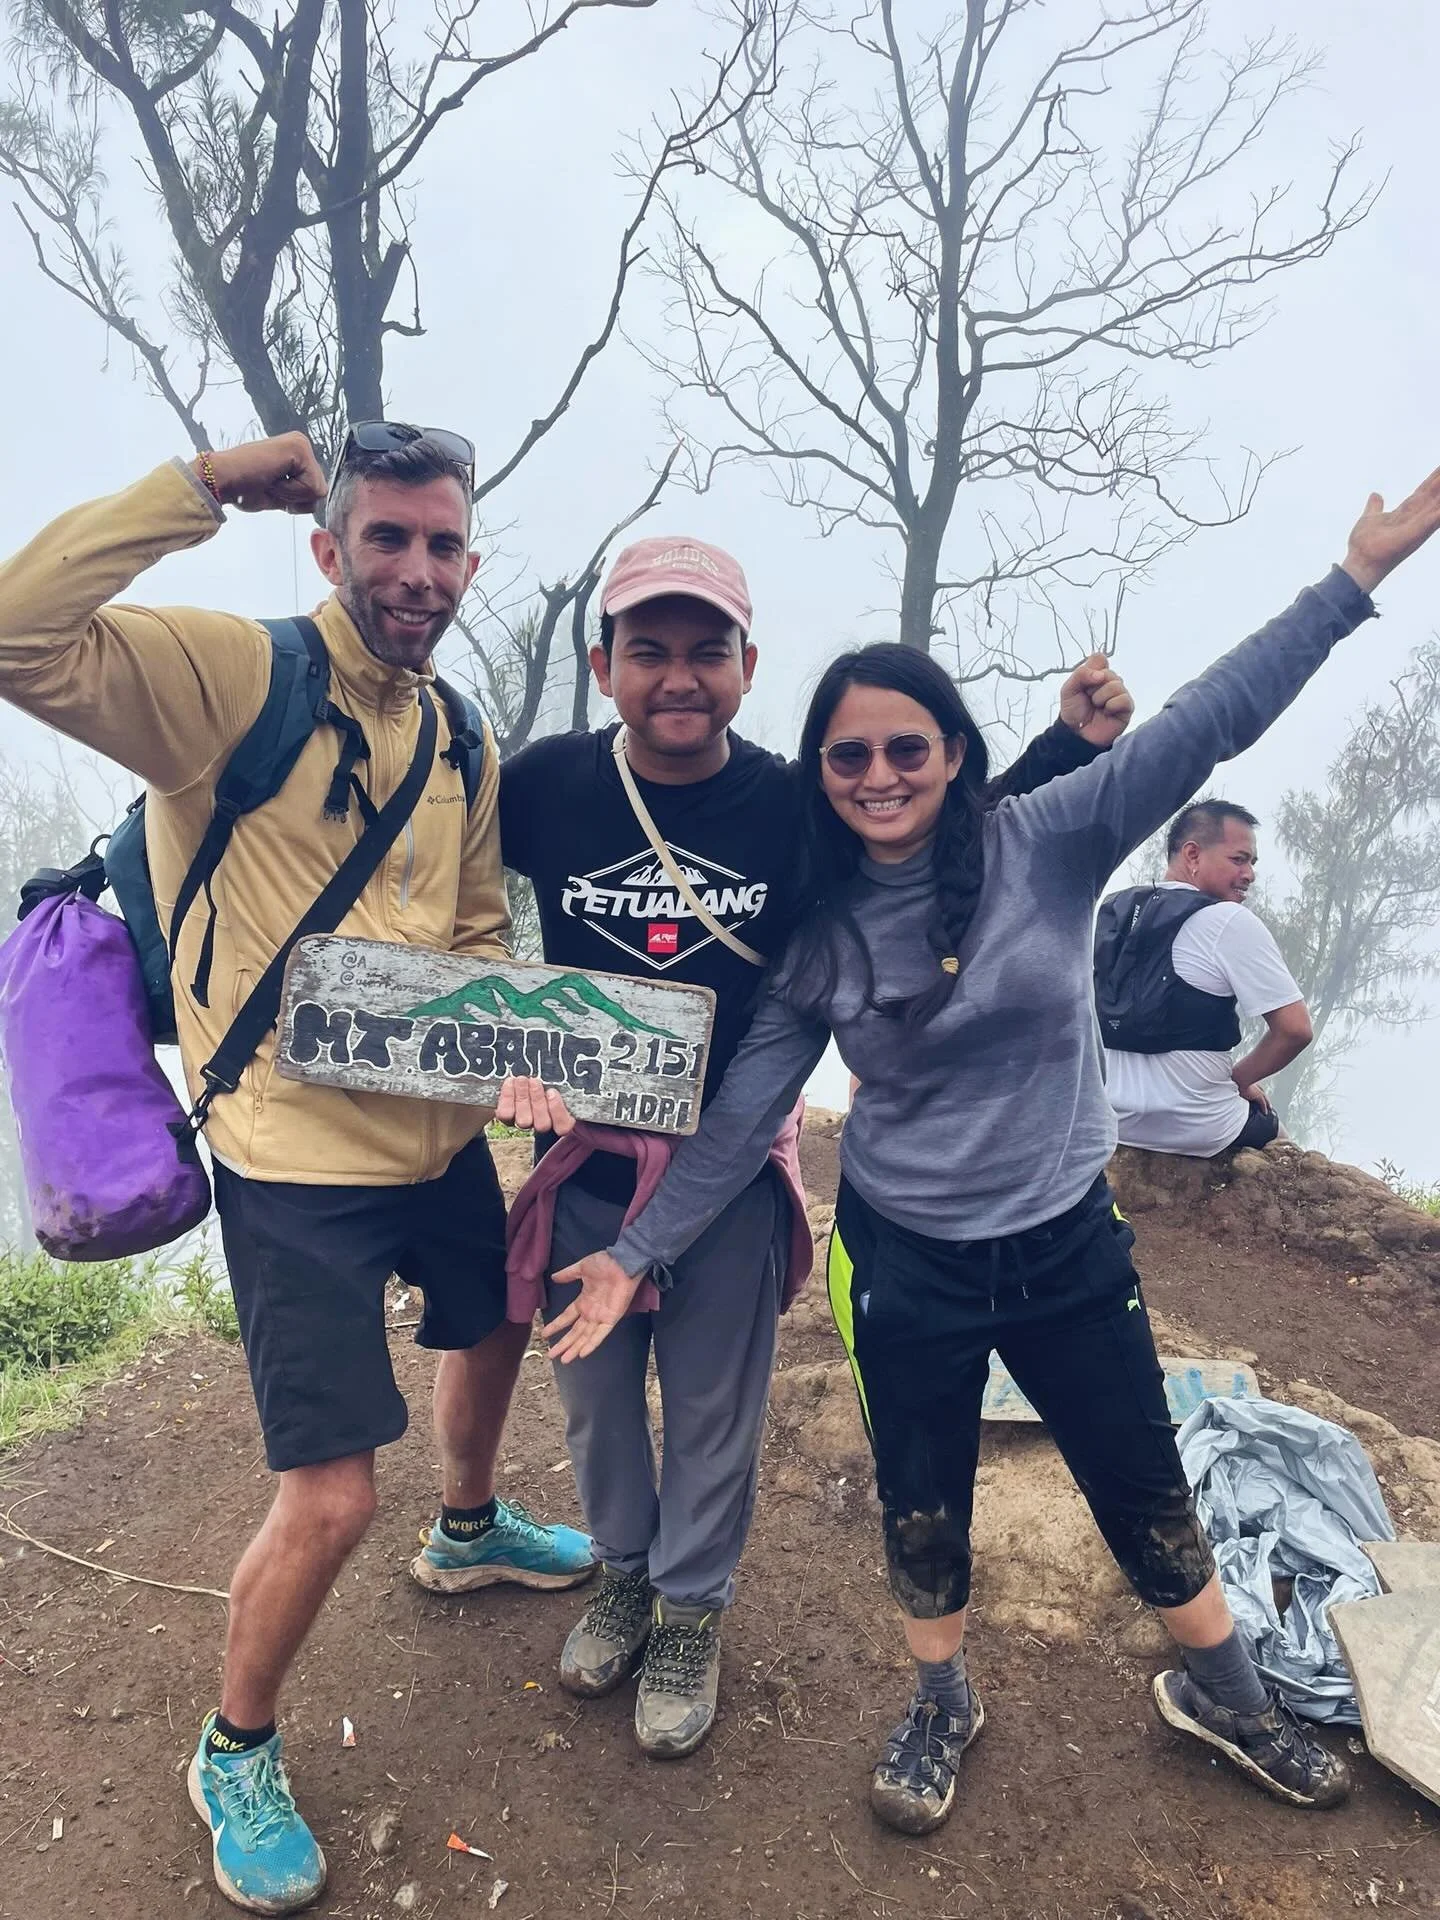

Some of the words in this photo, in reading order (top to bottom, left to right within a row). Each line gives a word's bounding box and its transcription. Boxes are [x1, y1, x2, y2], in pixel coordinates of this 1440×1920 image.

[561, 876, 768, 919] PETUALANG
[607, 1030, 704, 1080] 2.151
[448, 1515, 491, 1533] WORK
